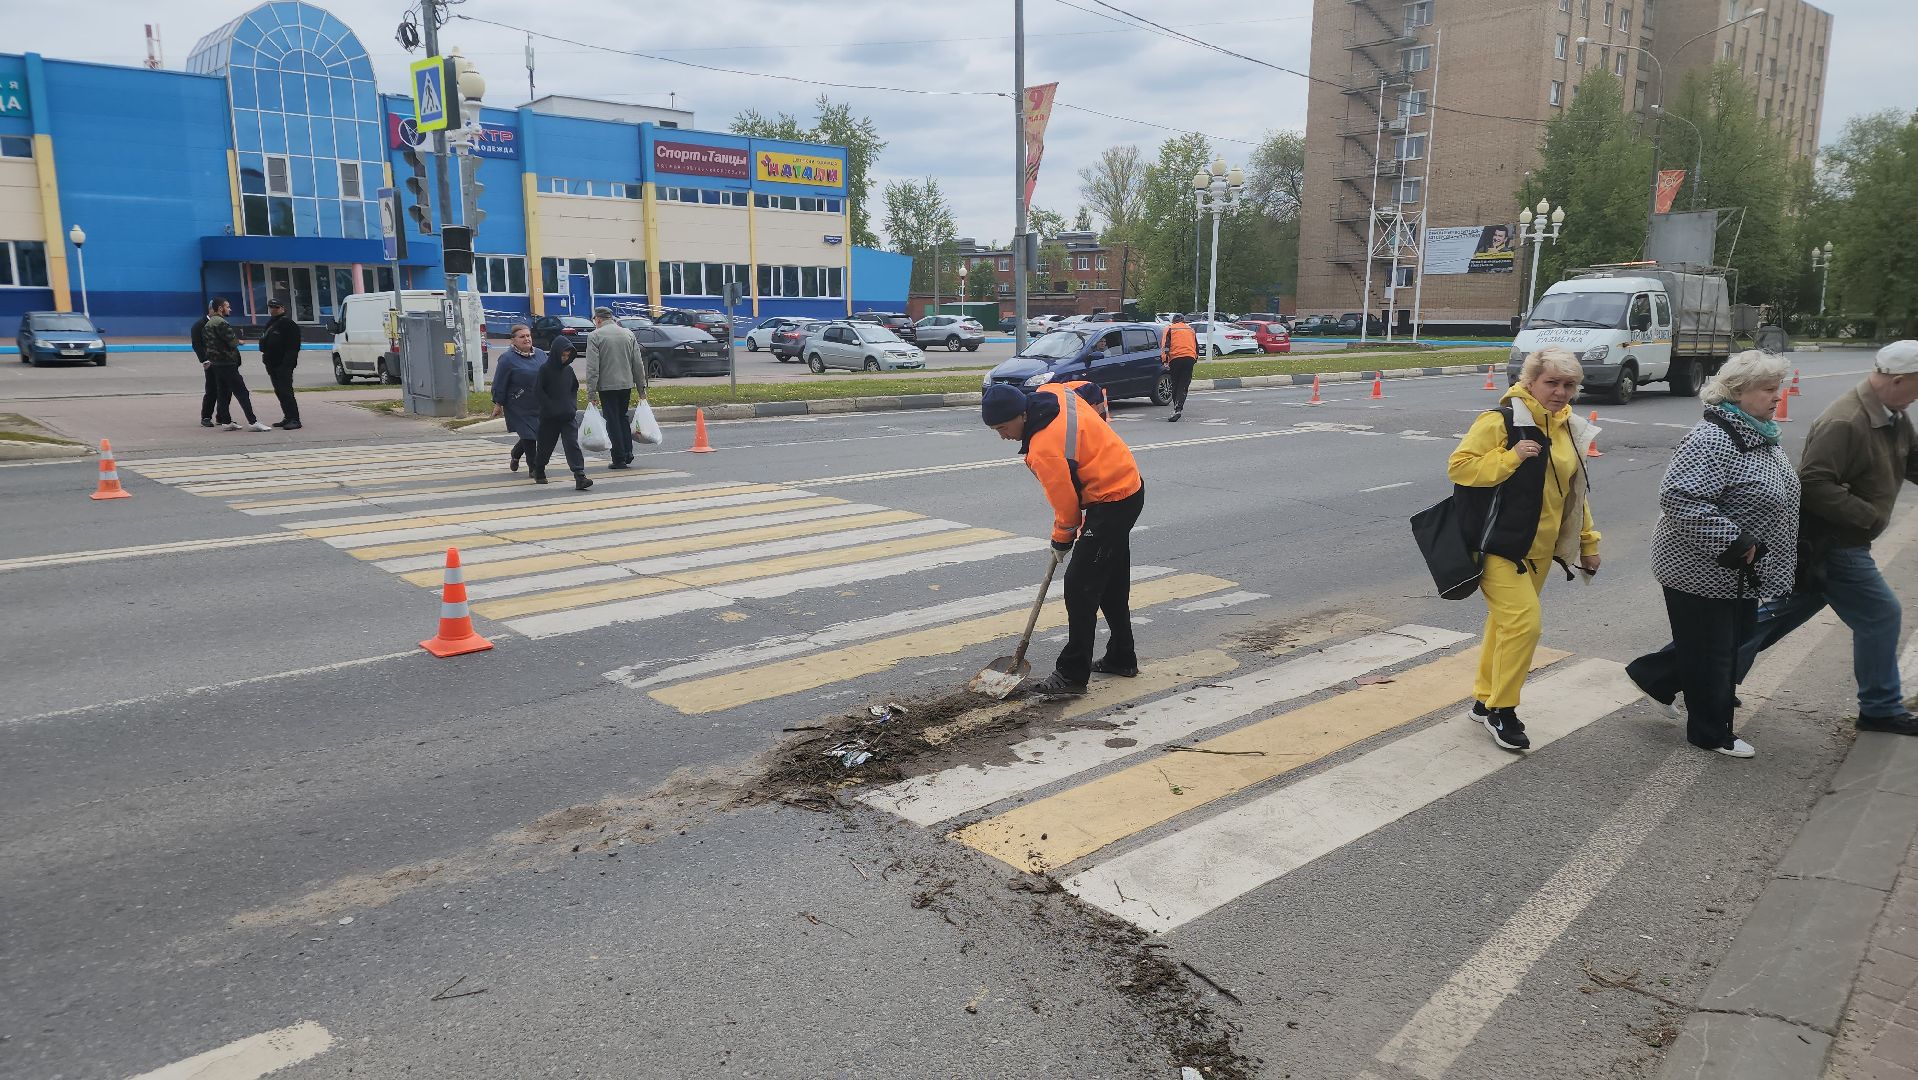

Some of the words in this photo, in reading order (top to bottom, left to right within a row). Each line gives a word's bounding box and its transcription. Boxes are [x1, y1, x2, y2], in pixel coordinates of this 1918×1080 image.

[1029, 89, 1044, 111] 9
[479, 129, 514, 142] КТР
[480, 144, 514, 153] ОДЕЖДА
[656, 146, 700, 162] Спорт
[707, 150, 747, 166] Танцы
[768, 163, 838, 182] НАТАЛИ
